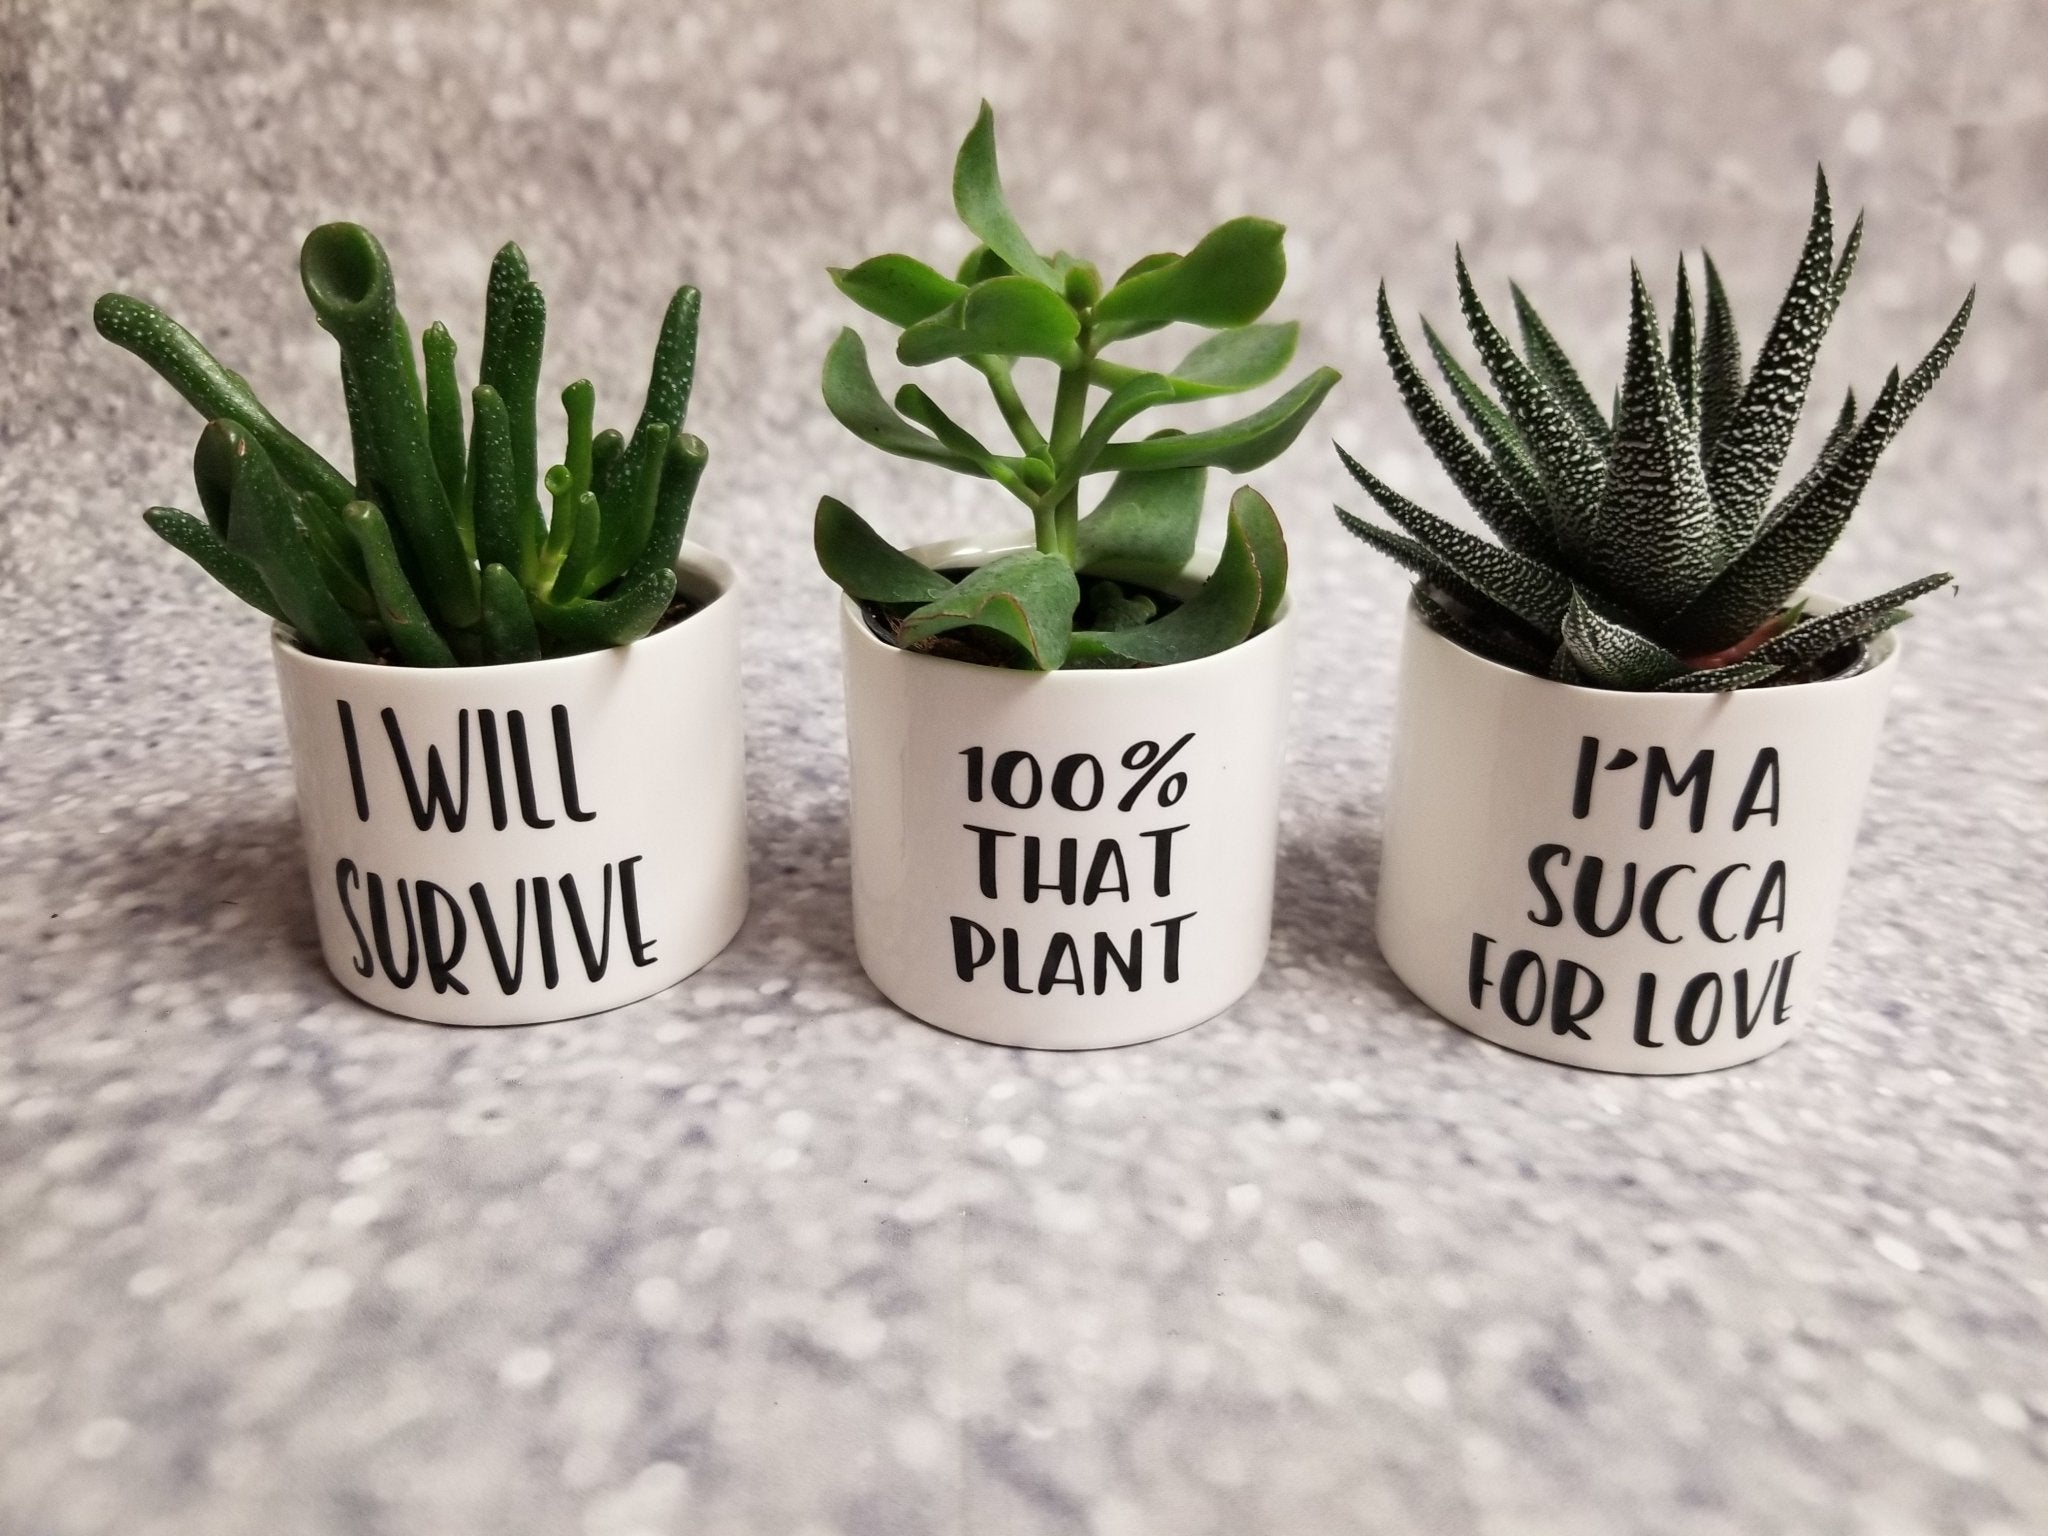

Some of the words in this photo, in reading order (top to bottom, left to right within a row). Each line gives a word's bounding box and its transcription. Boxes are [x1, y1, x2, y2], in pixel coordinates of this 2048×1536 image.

[336, 699, 370, 823] I
[379, 704, 597, 834] WILL
[958, 732, 1196, 812] 100%
[1571, 735, 1715, 834] I'M
[1732, 746, 1780, 832] A
[962, 823, 1191, 906] THAT
[1526, 842, 1786, 945] SUCCA
[335, 855, 658, 996] SURVIVE
[949, 911, 1198, 996] PLANT
[1468, 932, 1605, 1041] FOR
[1633, 950, 1801, 1049] LOVE
